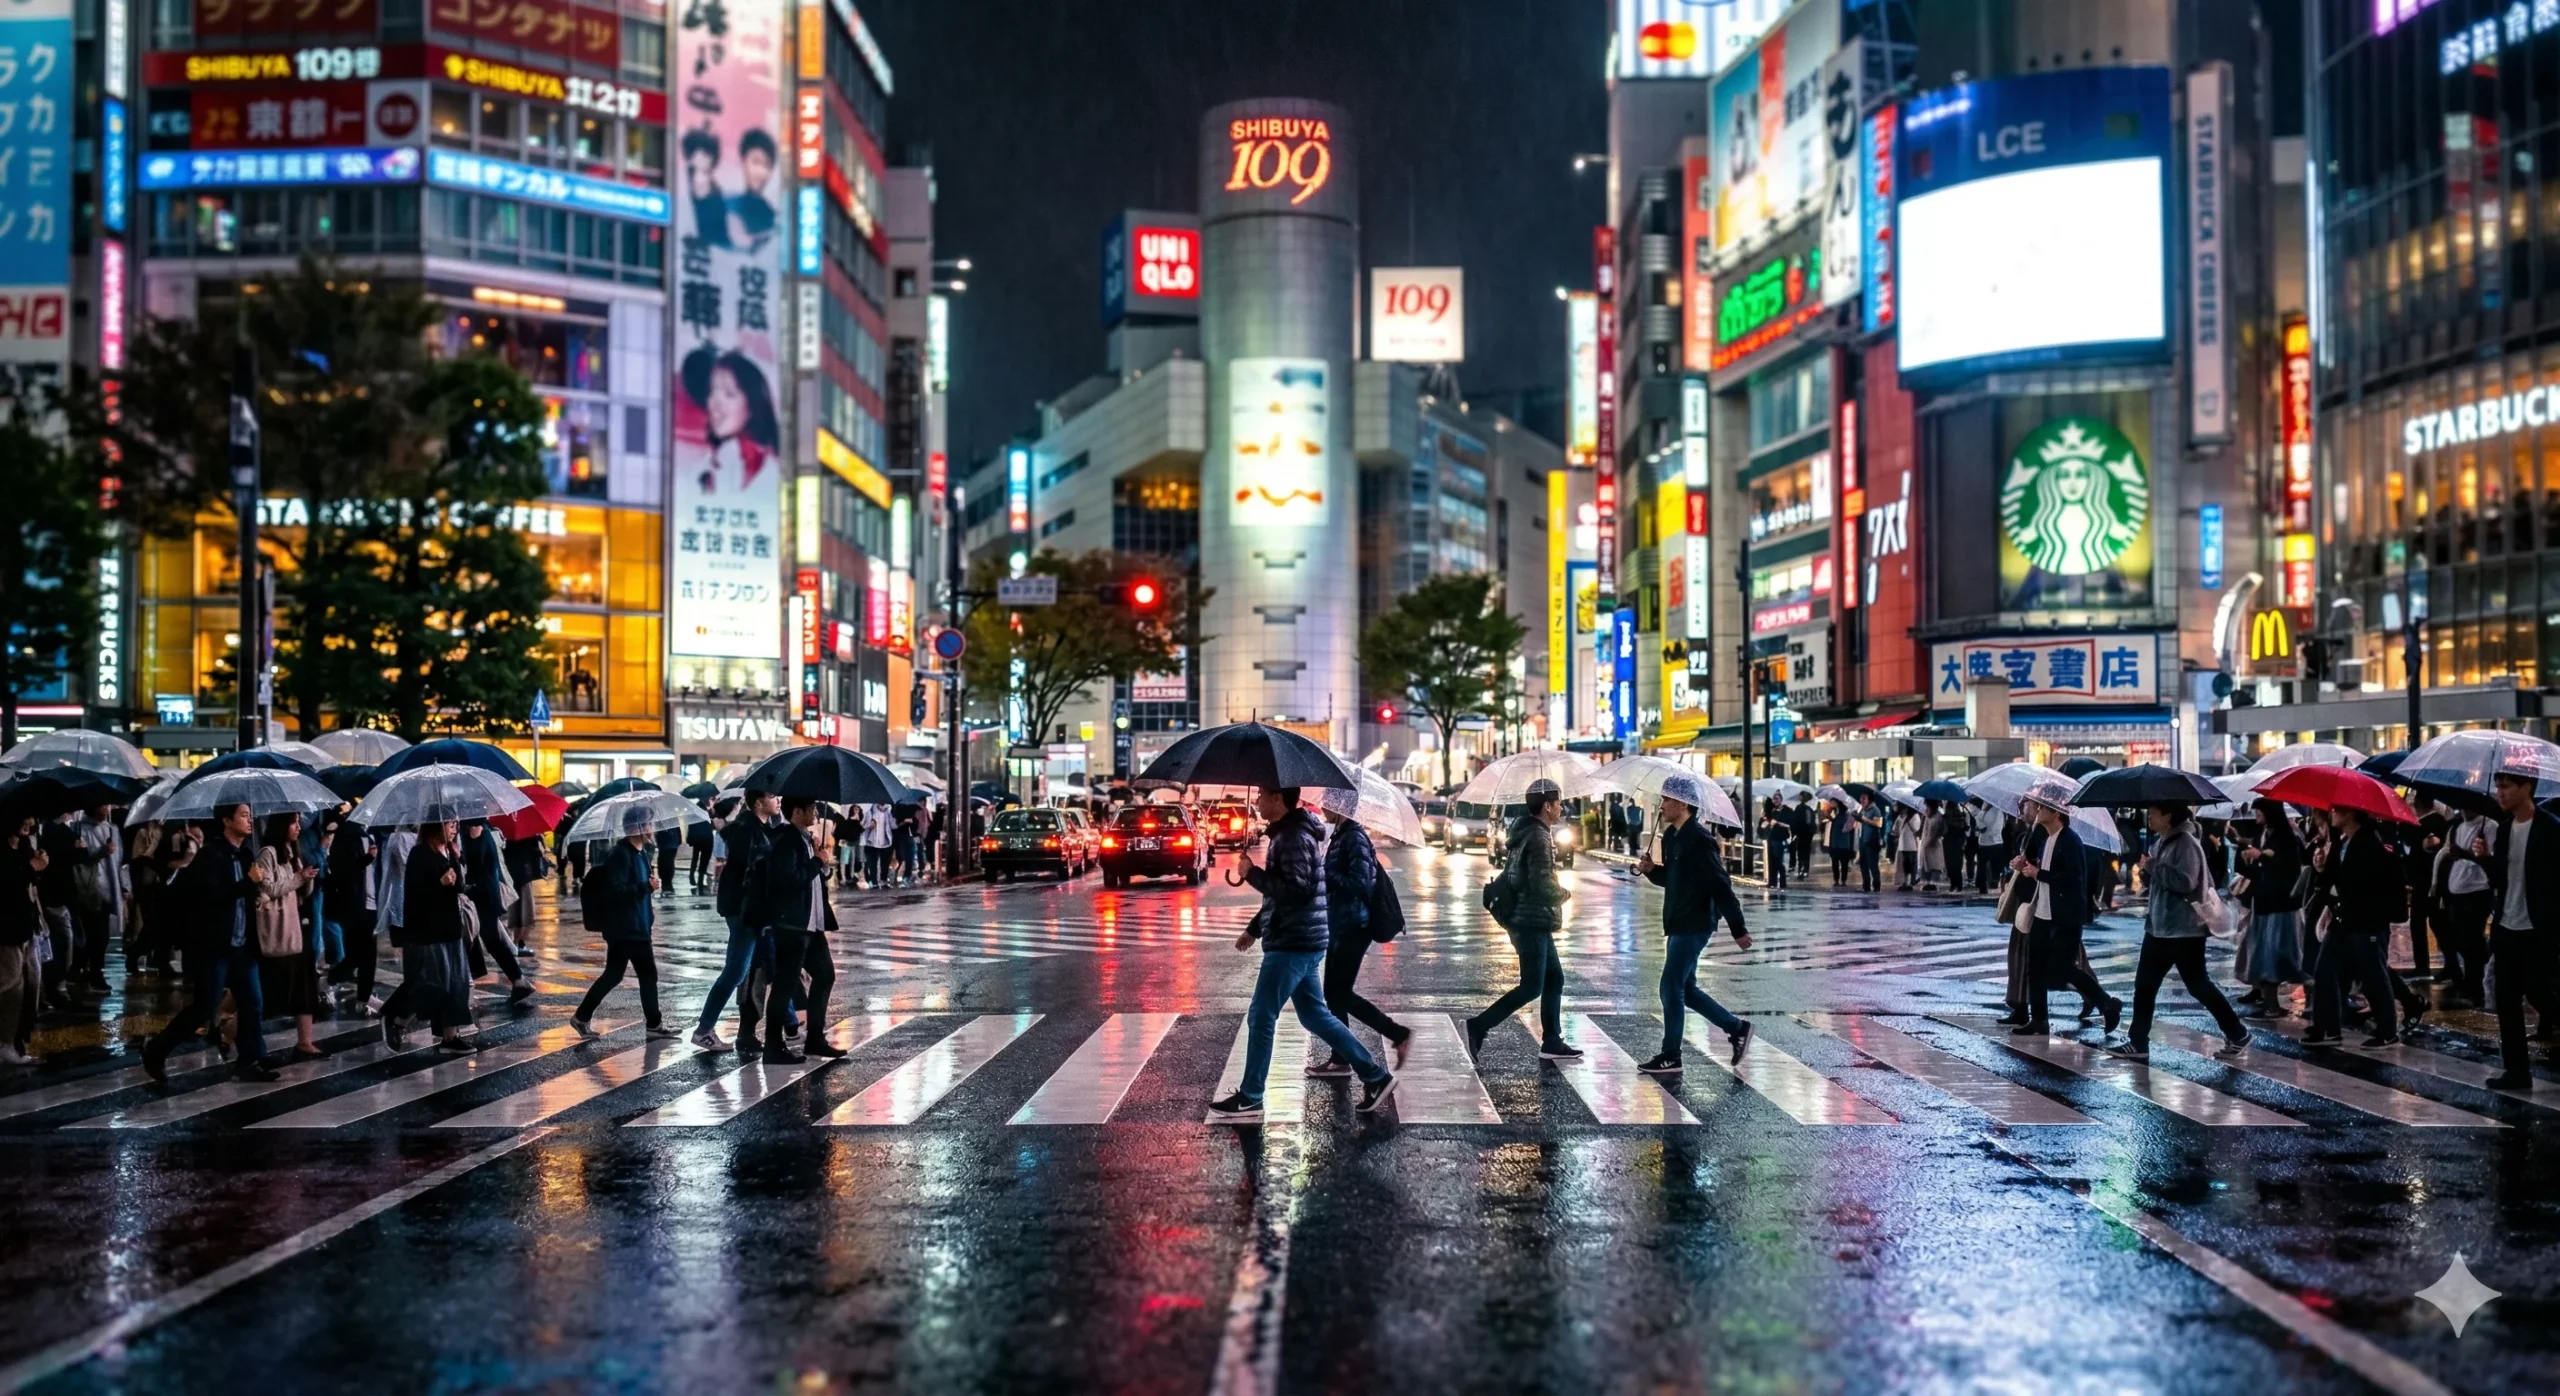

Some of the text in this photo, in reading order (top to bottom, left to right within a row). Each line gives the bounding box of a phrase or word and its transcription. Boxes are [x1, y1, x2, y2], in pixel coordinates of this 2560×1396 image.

[186, 55, 290, 80] SHIBUYA
[465, 59, 564, 100] SHIBUYA
[1230, 119, 1330, 141] SHIBUYA
[1978, 121, 2046, 162] LCE
[1224, 139, 1332, 206] 109
[1140, 234, 1189, 263] UNI
[1140, 263, 1195, 290] QLO
[1384, 284, 1451, 324] 109
